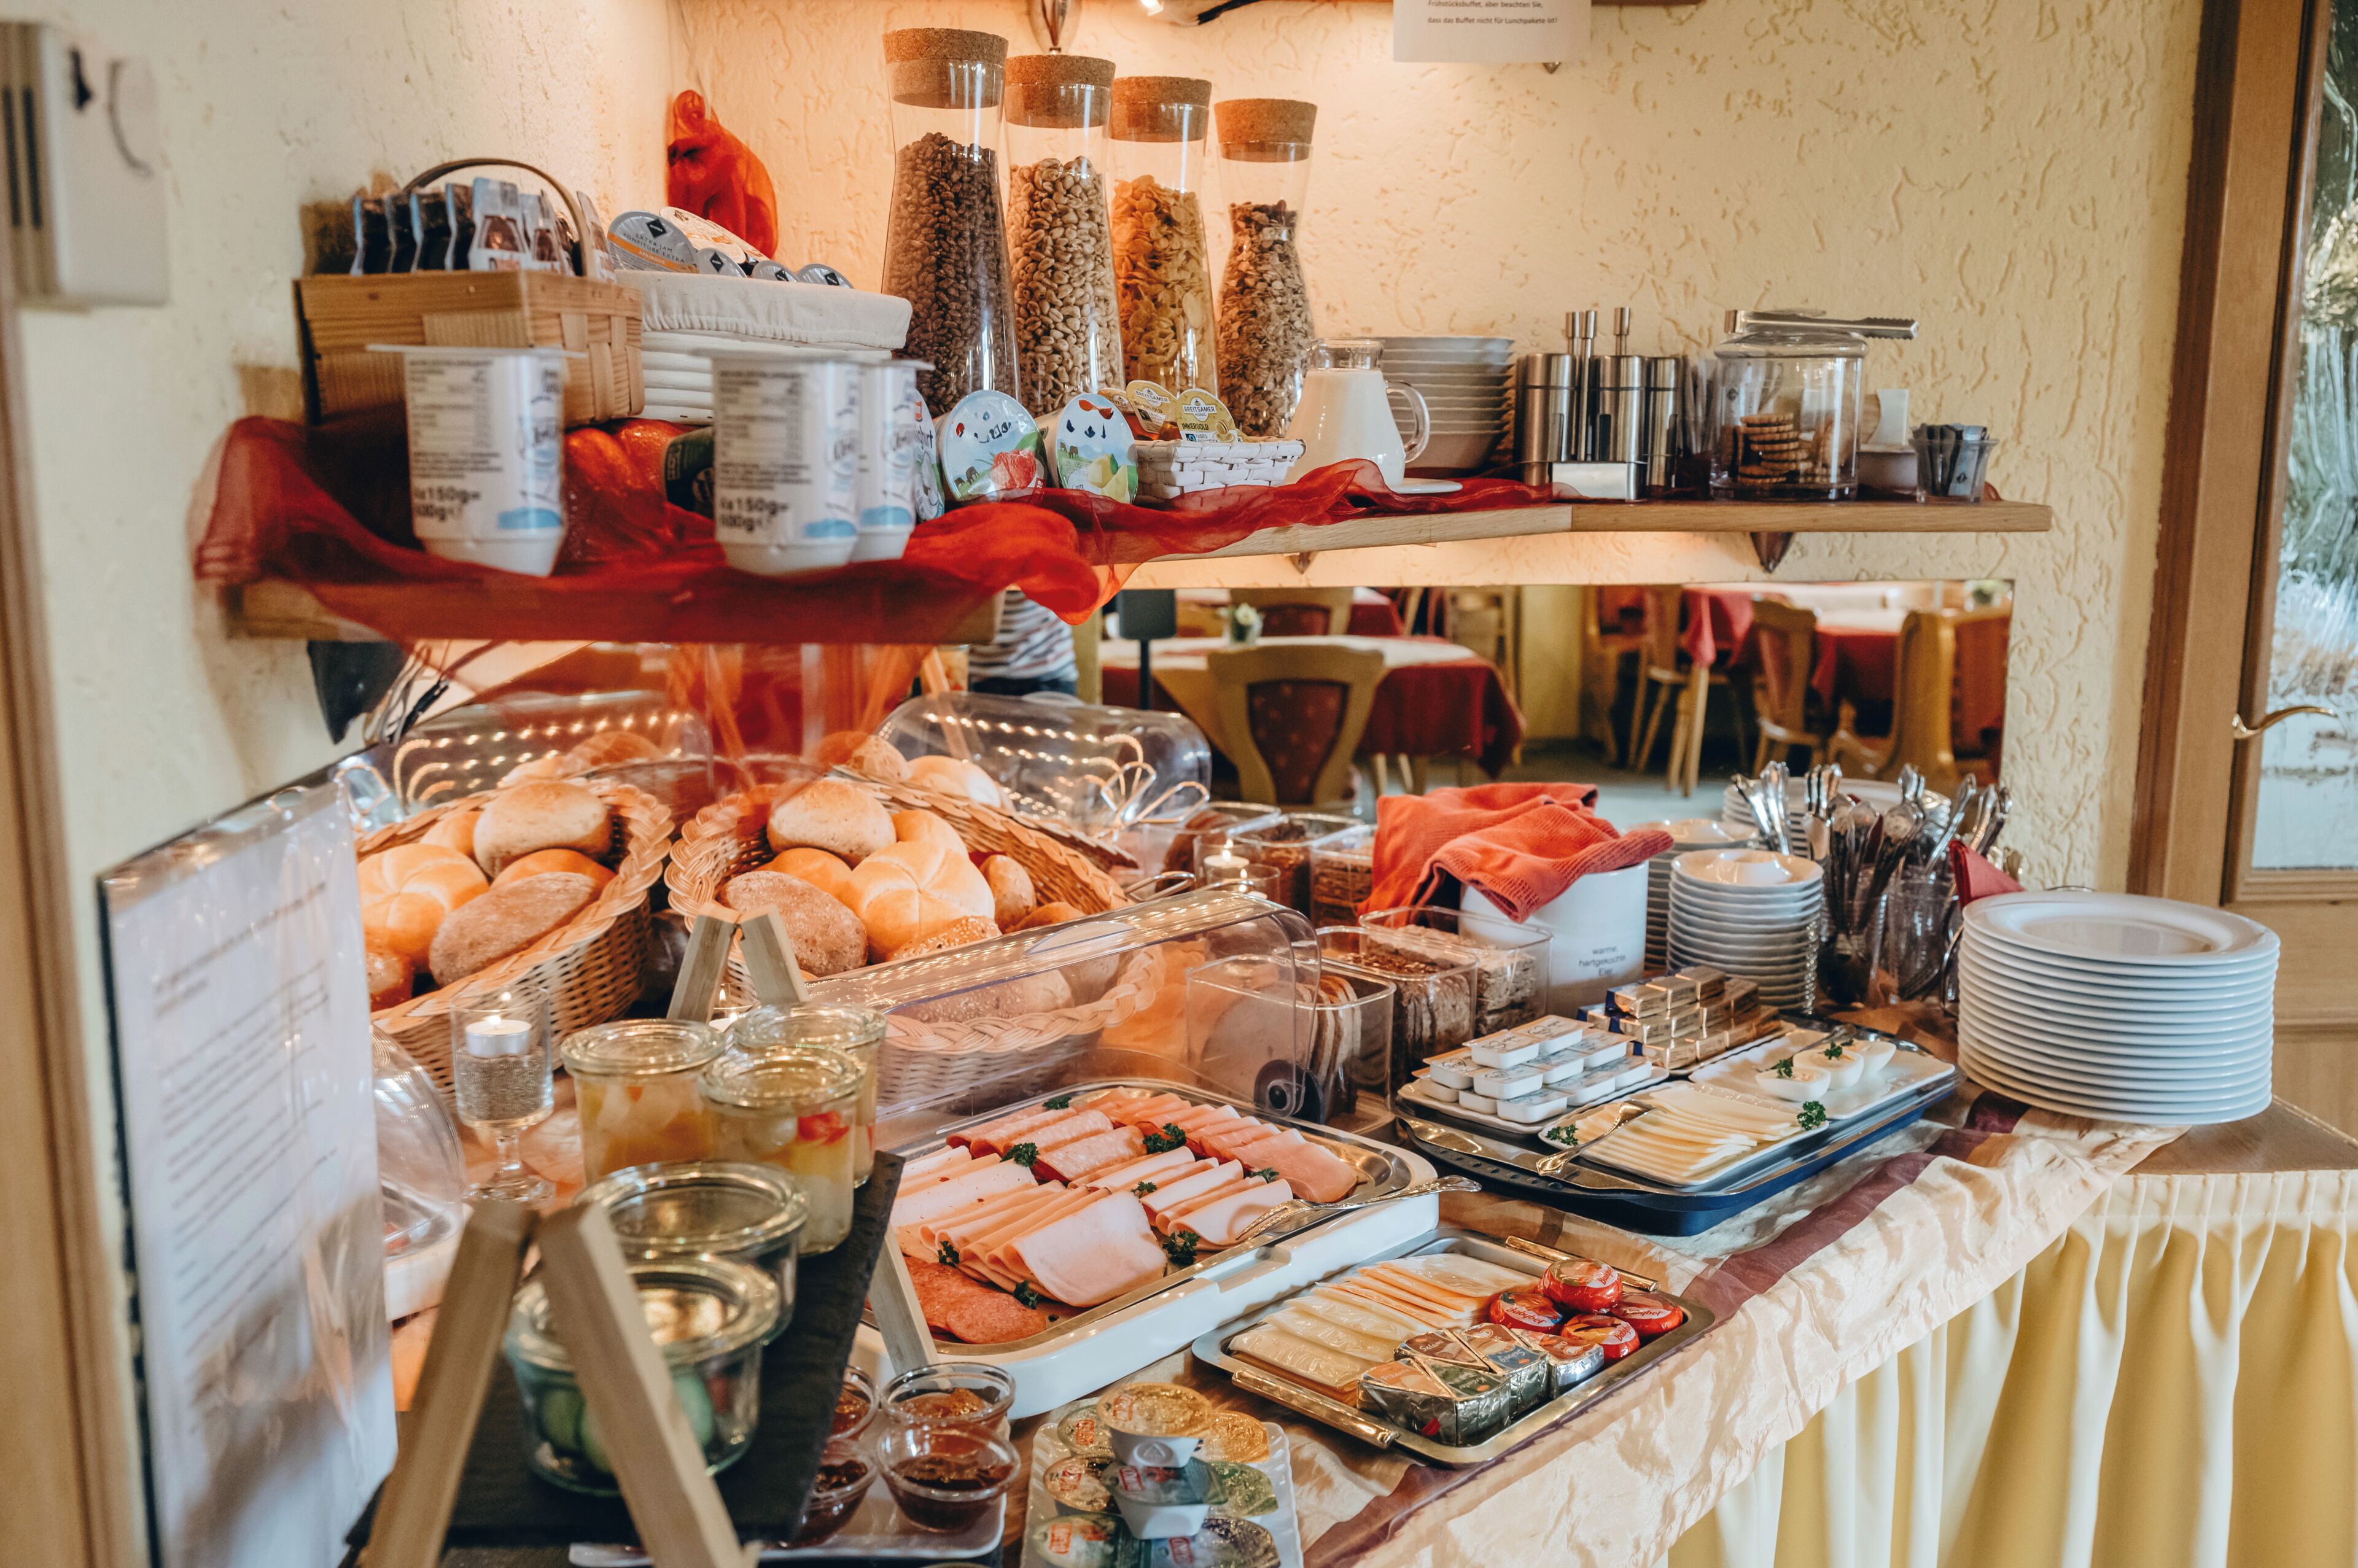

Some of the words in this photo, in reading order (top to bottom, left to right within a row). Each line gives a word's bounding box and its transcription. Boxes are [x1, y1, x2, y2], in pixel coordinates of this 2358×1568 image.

[636, 233, 658, 247] EXTRA
[638, 250, 666, 265] APRIKOSE
[662, 252, 685, 263] EXTRA
[1135, 390, 1169, 403] BREITSAMER
[1579, 954, 1626, 968] hartgekochte
[1598, 967, 1613, 976] Eier
[1506, 1305, 1547, 1325] Babybel
[1622, 1308, 1663, 1318] Babybel
[1419, 1338, 1444, 1352] Salami
[1497, 1348, 1526, 1362] Sahnig
